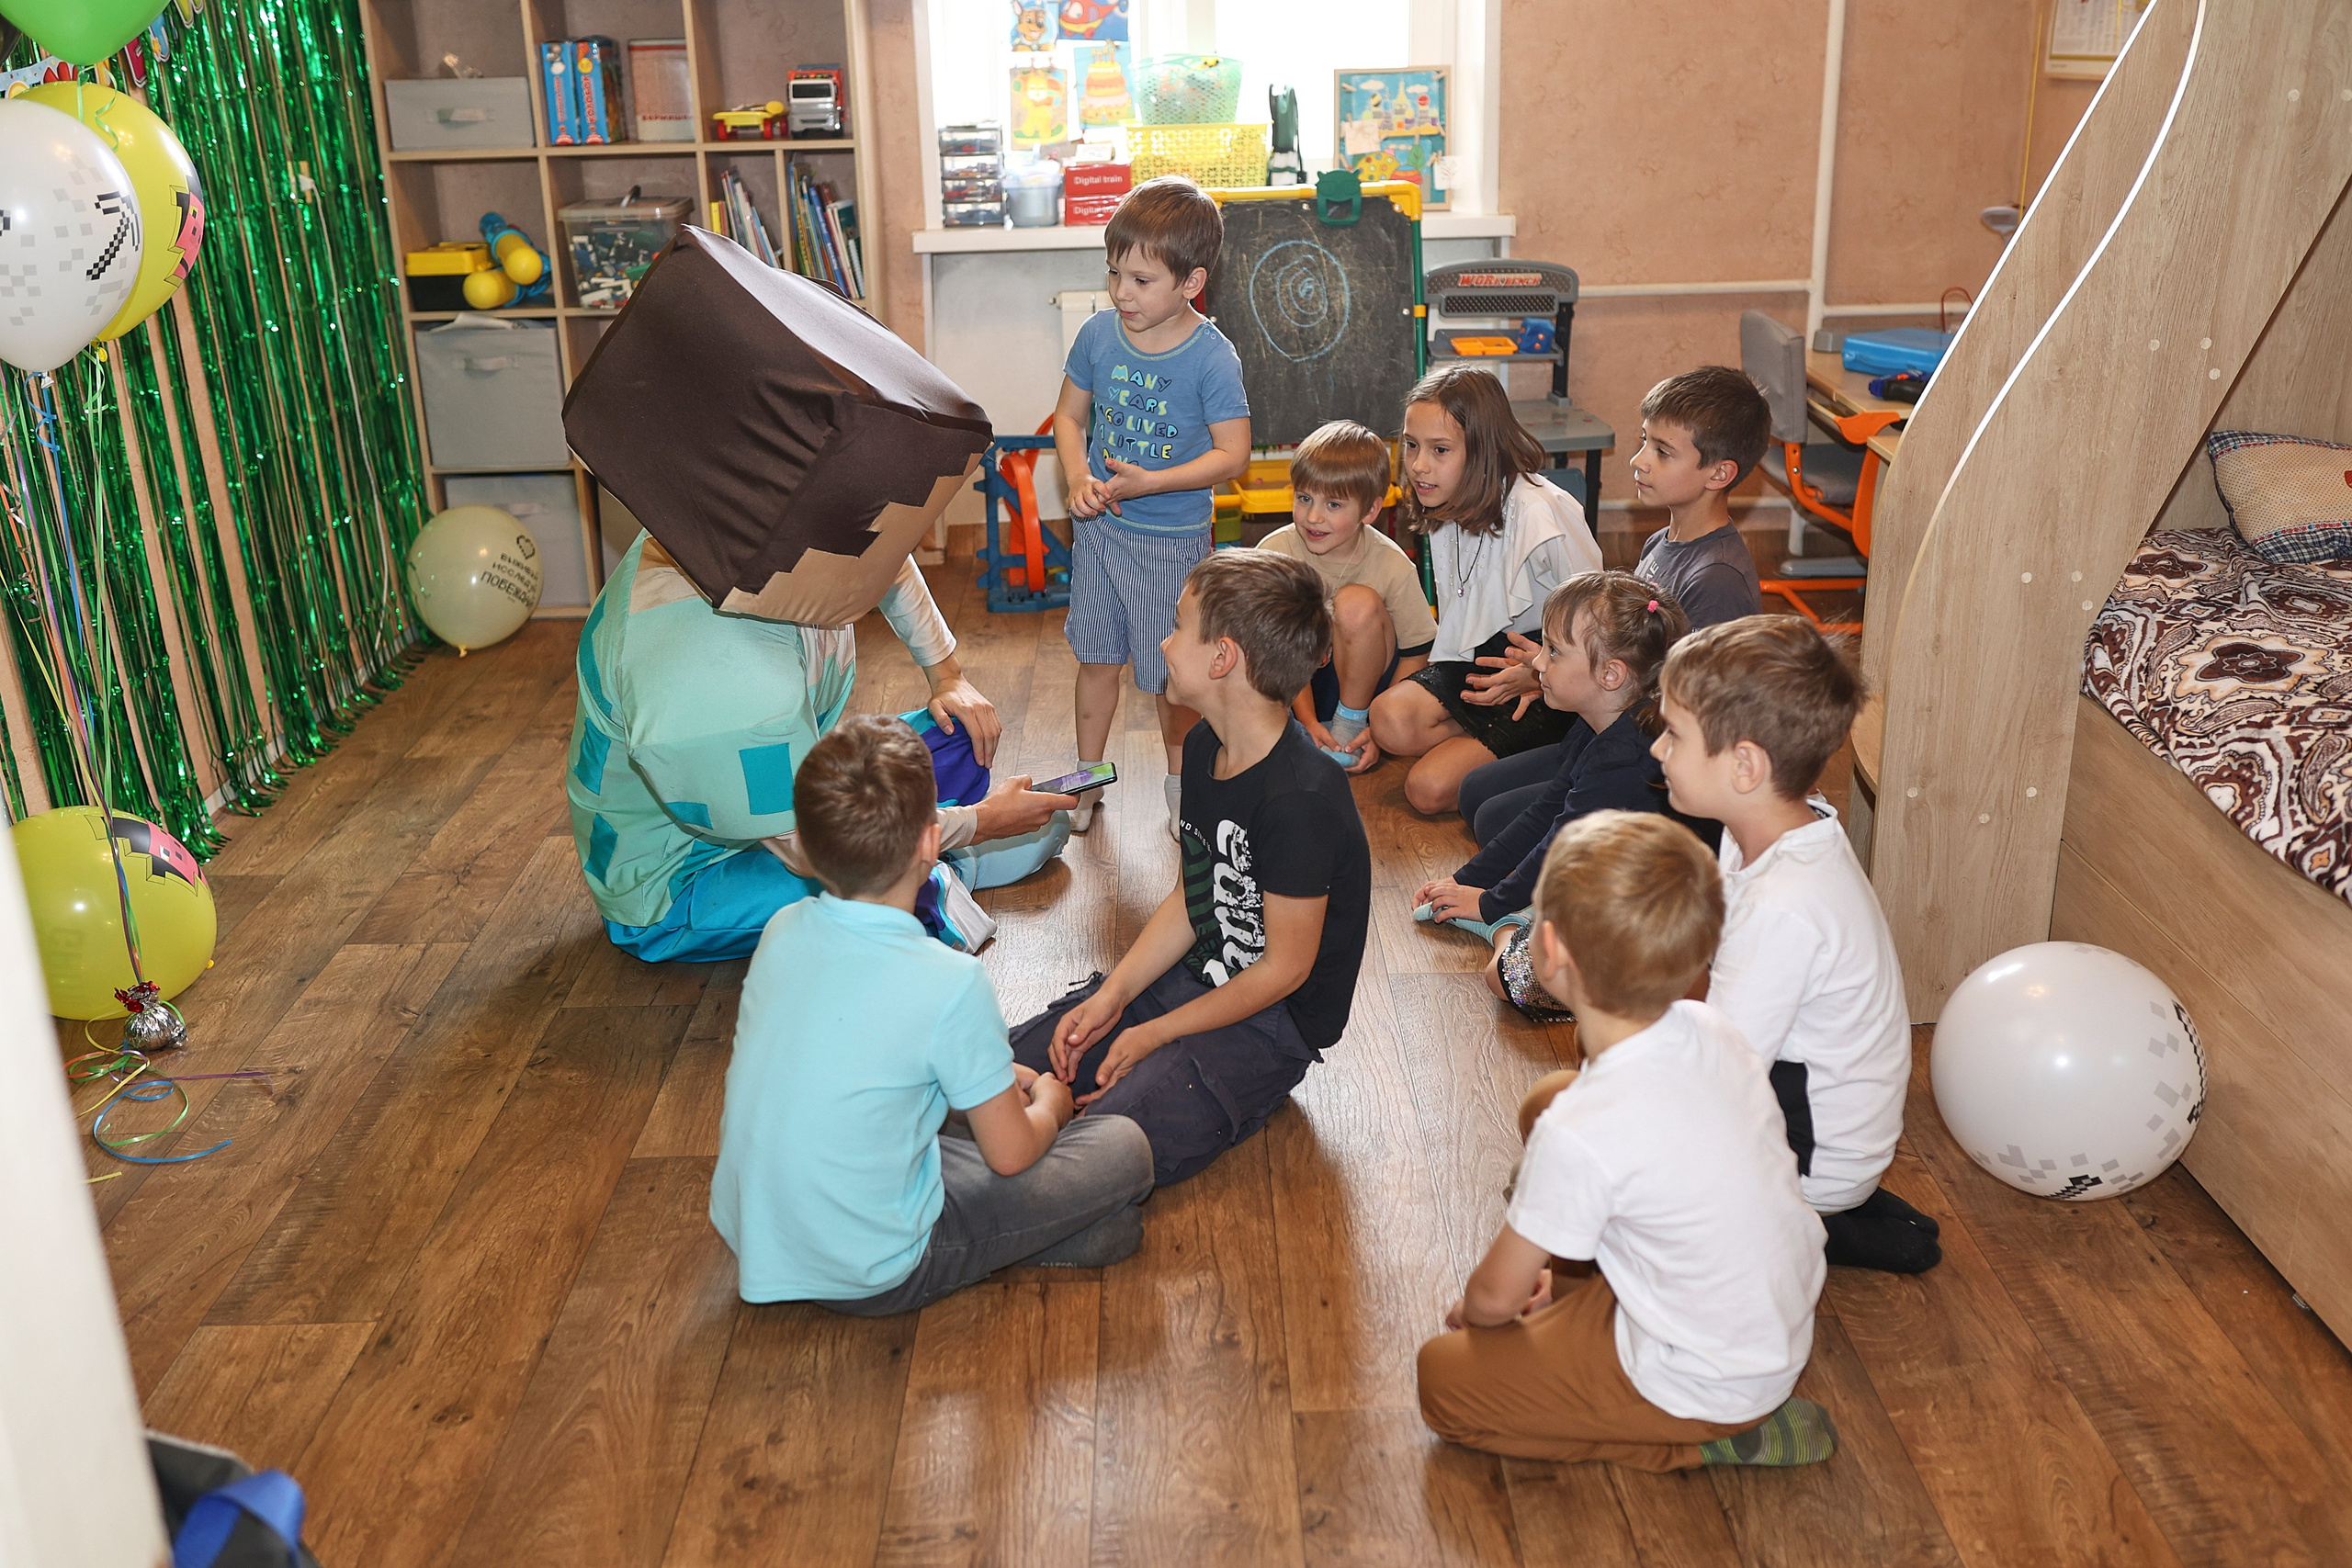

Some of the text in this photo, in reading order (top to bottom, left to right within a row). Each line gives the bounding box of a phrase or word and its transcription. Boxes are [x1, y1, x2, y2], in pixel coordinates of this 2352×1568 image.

[1073, 175, 1123, 186] Digital train
[1111, 365, 1172, 392] MANY
[1107, 386, 1168, 416] YEARS
[1125, 415, 1178, 438] LIVED
[1108, 431, 1173, 459] LITTLE
